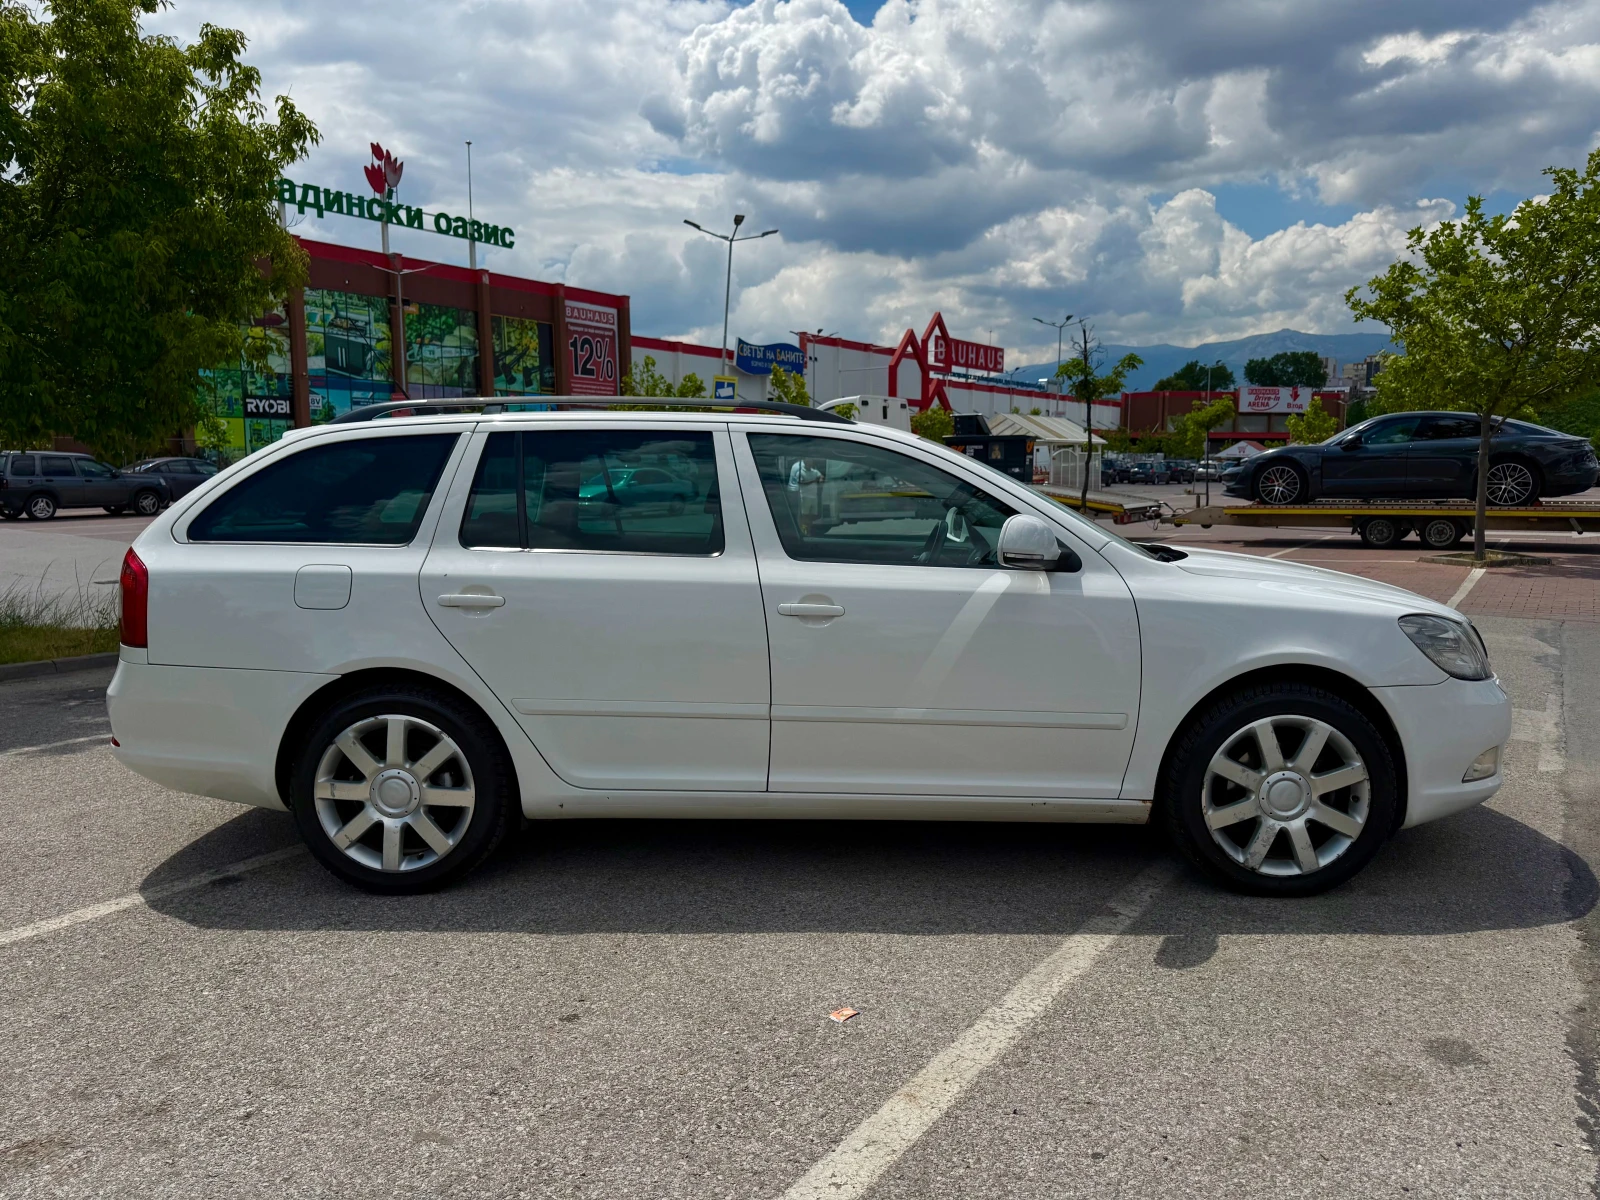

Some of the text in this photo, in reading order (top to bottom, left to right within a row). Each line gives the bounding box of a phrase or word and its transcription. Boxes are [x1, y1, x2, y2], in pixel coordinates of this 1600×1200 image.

[268, 178, 515, 249] адински оазис
[565, 306, 614, 324] BAUHAUS
[569, 334, 614, 381] 12%
[245, 398, 291, 414] RYOBI
